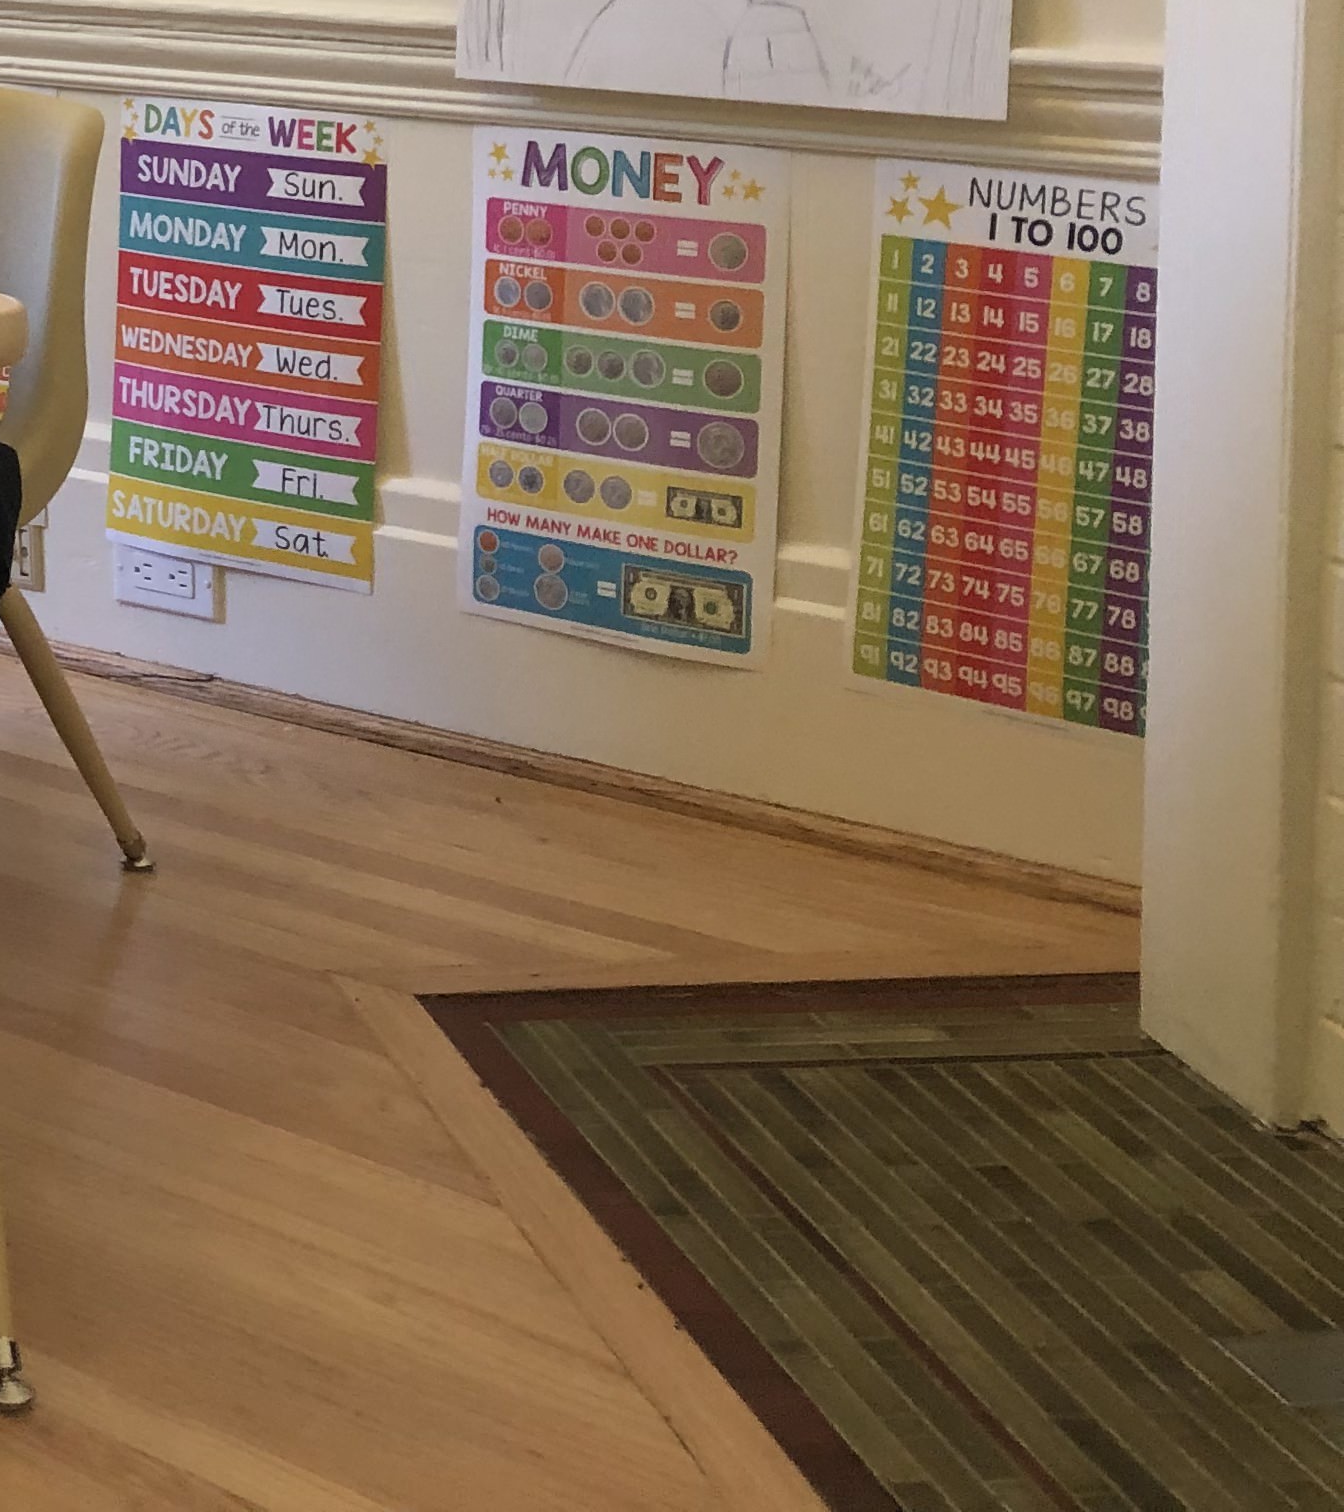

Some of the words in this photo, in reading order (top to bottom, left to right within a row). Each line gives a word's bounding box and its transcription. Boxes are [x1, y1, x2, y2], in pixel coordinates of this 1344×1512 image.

[144, 102, 216, 141] DAYS
[222, 120, 236, 135] of
[238, 121, 260, 137] the
[269, 116, 358, 154] WEEK
[137, 154, 243, 193] SUNDAY
[284, 172, 344, 201] Sun.
[521, 141, 724, 206] MONEY
[503, 201, 548, 217] PENNY
[968, 177, 1146, 227] NUMBERS
[129, 211, 246, 252] MONDAY
[278, 233, 345, 262] Mon.
[988, 213, 998, 240] 1
[1011, 216, 1054, 246] TO
[1067, 222, 1123, 255] 100
[499, 263, 548, 280] NICKEL
[891, 249, 898, 269] 1
[921, 254, 934, 274] 2
[955, 259, 969, 278] 3
[988, 264, 1003, 283] 4
[1024, 267, 1039, 288] 5
[129, 267, 243, 310] TUESDAY
[276, 289, 344, 322] Tues.
[121, 325, 253, 368] WEDNESDAY
[276, 347, 339, 381] Wed.
[503, 325, 539, 342] DIME
[119, 376, 251, 426] THURSDAY
[262, 405, 350, 442] Thurs.
[495, 385, 544, 402] QUARTER
[128, 436, 229, 481] FRIDAY
[281, 468, 324, 499] Fri.
[112, 491, 246, 543] SATURDAY
[487, 507, 520, 526] HOW
[526, 515, 572, 536] MANY
[577, 524, 622, 545] MAKE
[626, 534, 659, 551] ONE
[664, 540, 738, 565] DOLLAR?
